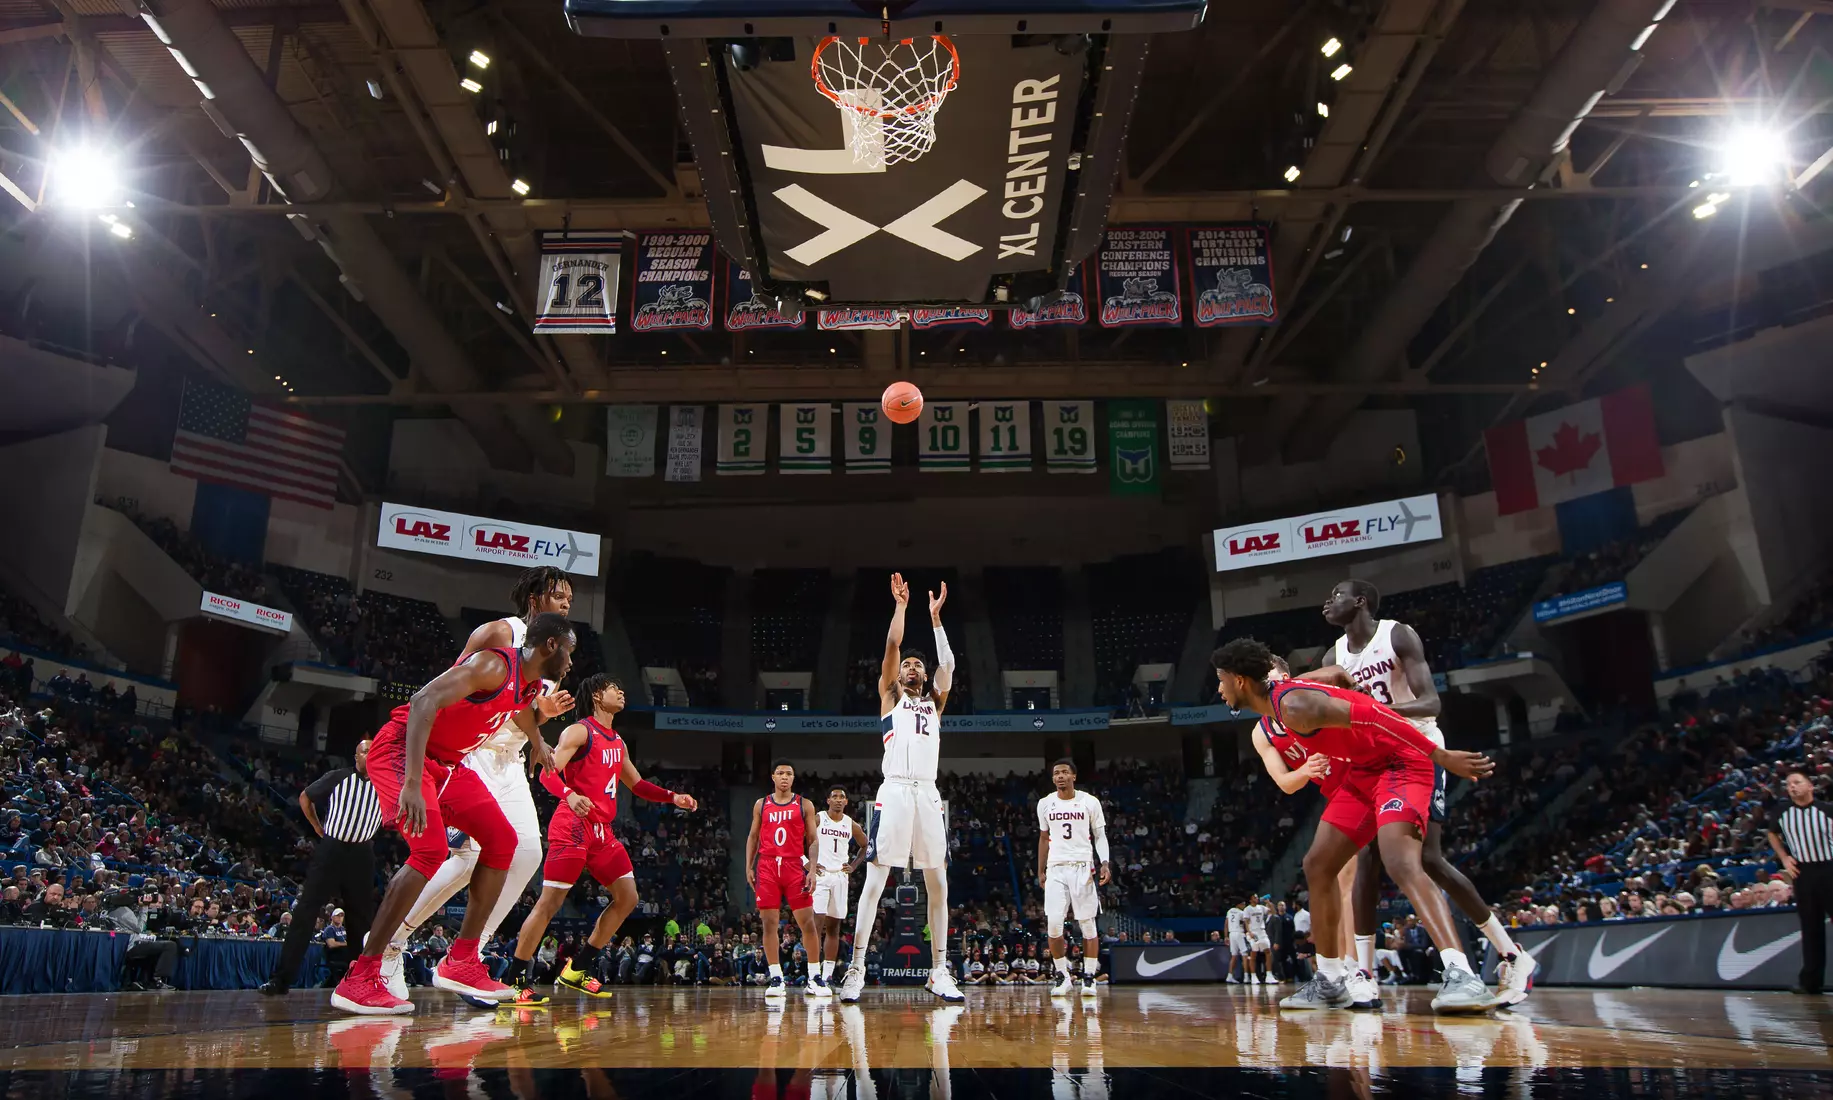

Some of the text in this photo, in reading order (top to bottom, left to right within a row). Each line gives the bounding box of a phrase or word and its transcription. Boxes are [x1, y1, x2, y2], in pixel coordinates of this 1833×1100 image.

[997, 73, 1060, 260] XL CENTER
[641, 235, 710, 246] 1999-2000
[1107, 231, 1166, 240] 2003-2004
[1110, 240, 1163, 249] EASTERN
[1193, 239, 1264, 248] NORTHEAST
[647, 246, 703, 258] REGULAR
[1101, 251, 1170, 261] CONFERENCE
[1203, 248, 1256, 257] DIVISION
[552, 259, 609, 272] GERNANDER
[650, 258, 699, 269] SEASON
[1101, 261, 1170, 270] CHAMPIONS
[1195, 256, 1266, 266] CHAMPIONS
[638, 270, 709, 283] CHAMPIONS
[552, 274, 604, 308] 12
[733, 429, 751, 457] 2
[796, 427, 815, 453] 5
[859, 426, 877, 455] 9
[929, 425, 960, 451] 10
[990, 425, 1019, 451] 11
[1053, 427, 1087, 455] 19
[395, 518, 451, 541] LAZ
[1304, 515, 1399, 544] LAZ FLY
[475, 529, 566, 557] LAZ FLY
[1229, 532, 1281, 555] LAZ
[1307, 535, 1373, 550] AIRPORT PARKING
[475, 547, 539, 560] AIRPORT PARKING
[374, 569, 393, 581] 232
[1280, 587, 1298, 599] 239
[210, 596, 240, 609] RICOH
[256, 608, 285, 621] RICOH
[1351, 659, 1394, 683] CONN
[273, 707, 288, 716] 107
[667, 717, 689, 725] Let's
[707, 718, 744, 728] Huskies!
[802, 720, 877, 728] Let's Go Huskies!
[915, 713, 929, 736] 12
[959, 719, 973, 727] Go
[975, 718, 1012, 727] Huskies!
[1070, 717, 1108, 725] Let's Go
[602, 748, 621, 768] NJIT
[605, 773, 617, 799] 4
[769, 810, 794, 824] NJIT
[1049, 812, 1084, 821] UCONN
[774, 827, 787, 847] 0
[821, 828, 851, 839] UCONN
[1062, 823, 1072, 840] 3
[833, 839, 838, 853] 1
